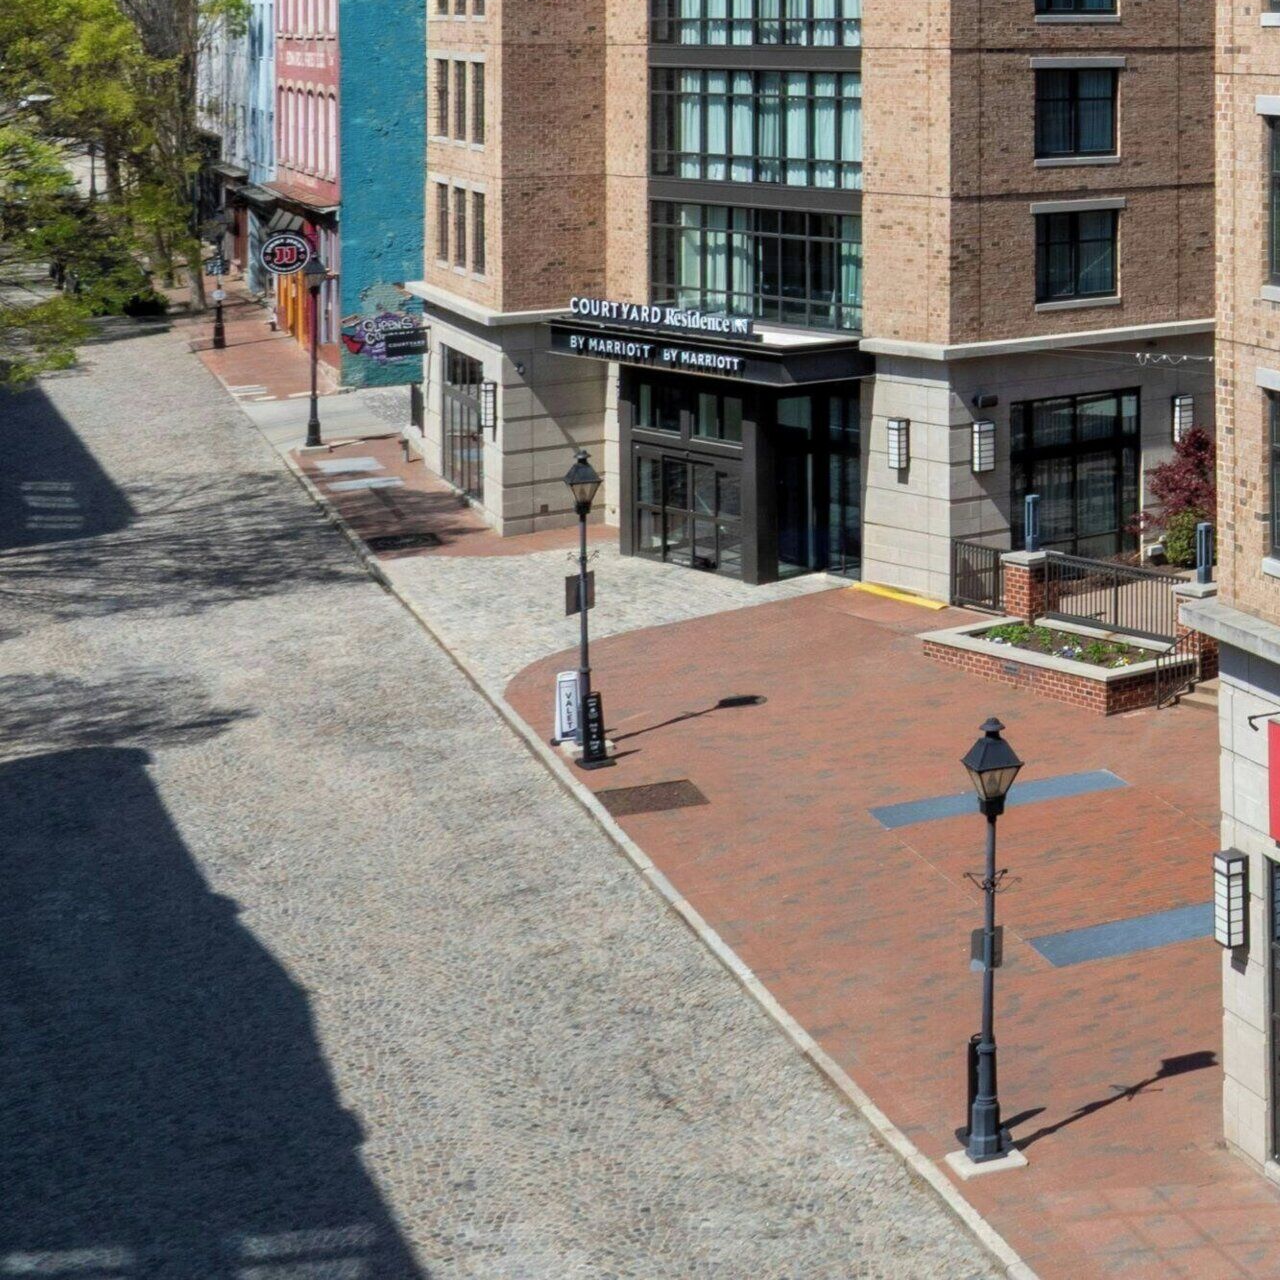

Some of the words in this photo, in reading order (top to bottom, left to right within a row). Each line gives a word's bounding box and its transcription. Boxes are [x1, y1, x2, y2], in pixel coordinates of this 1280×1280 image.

[570, 297, 661, 324] COURTYARD
[664, 307, 730, 333] Residence
[570, 335, 585, 349] BY
[588, 337, 651, 359] MARRIOTT
[663, 348, 678, 362] BY
[681, 351, 740, 371] MARRIOTT
[565, 692, 575, 730] VALET
